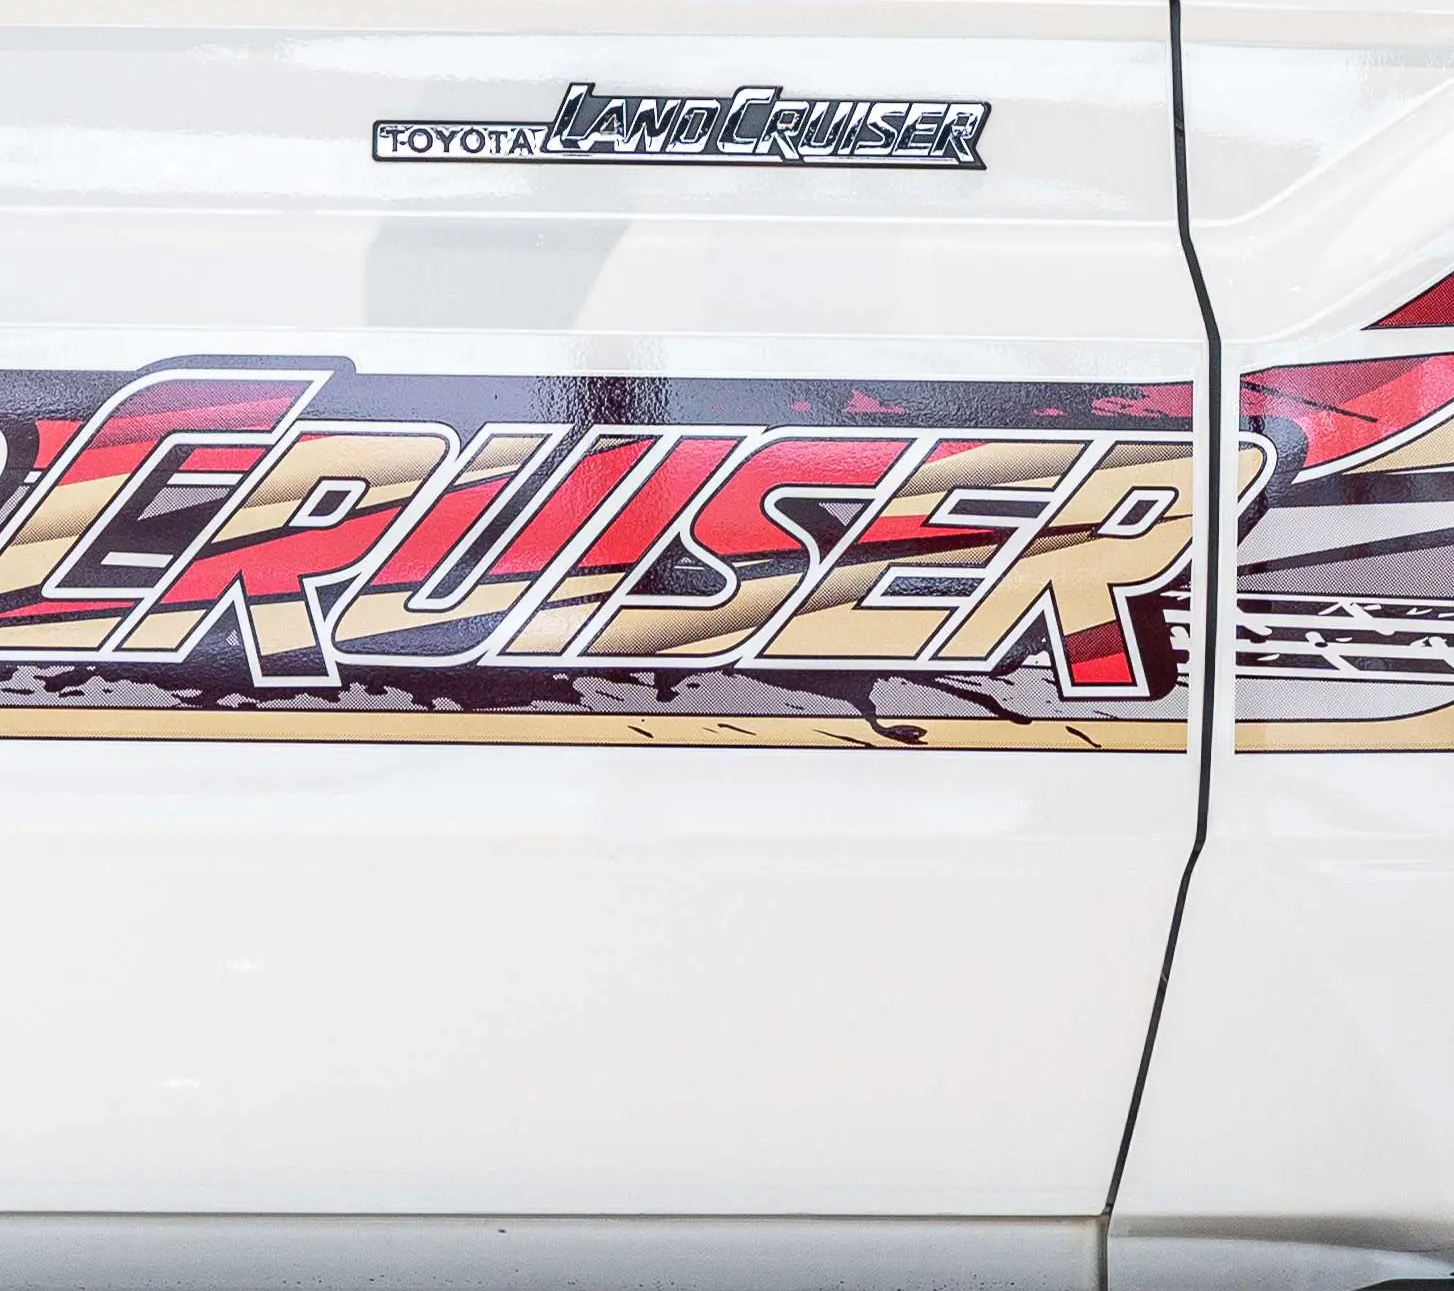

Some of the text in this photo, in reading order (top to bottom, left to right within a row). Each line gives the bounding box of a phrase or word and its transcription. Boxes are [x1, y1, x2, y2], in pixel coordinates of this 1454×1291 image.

[382, 82, 980, 165] TOYOTA LAND CRUISER
[0, 368, 1277, 699] CRUISER
